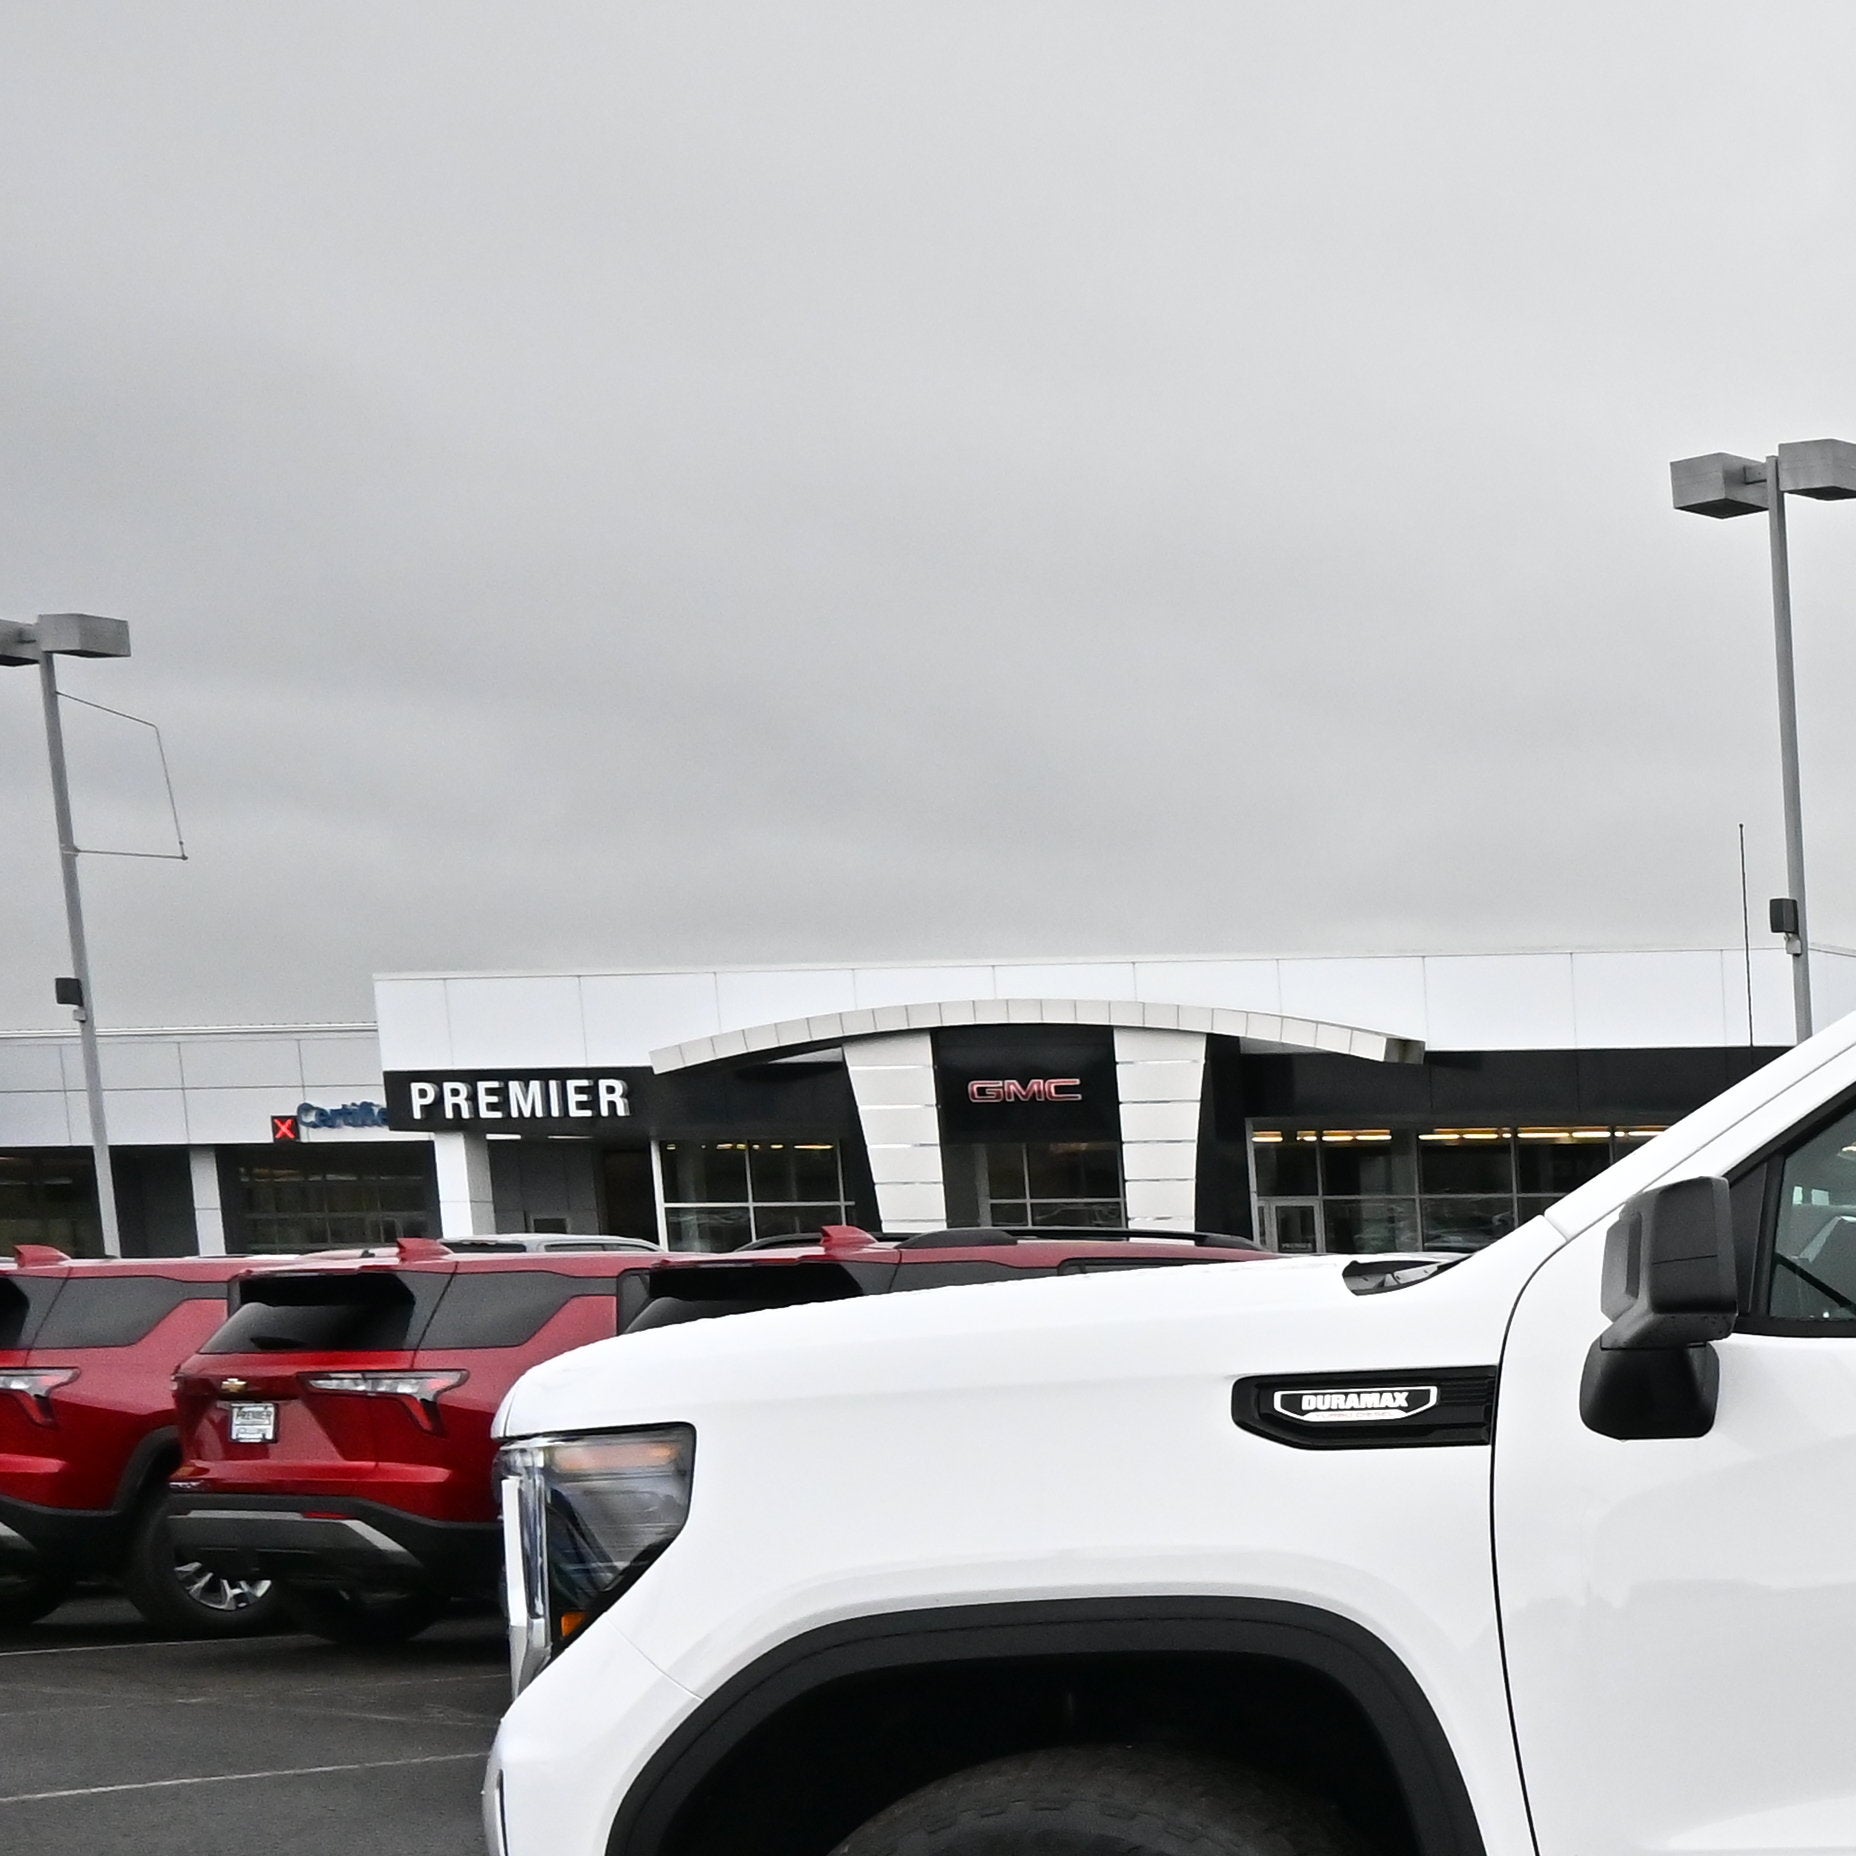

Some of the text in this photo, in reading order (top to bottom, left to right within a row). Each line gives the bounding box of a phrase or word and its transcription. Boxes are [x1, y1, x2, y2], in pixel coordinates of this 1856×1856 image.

[410, 1078, 630, 1120] PREMIER
[968, 1078, 1082, 1103] GMC
[297, 1101, 390, 1129] Certifie
[1302, 1392, 1409, 1411] DURAMAX
